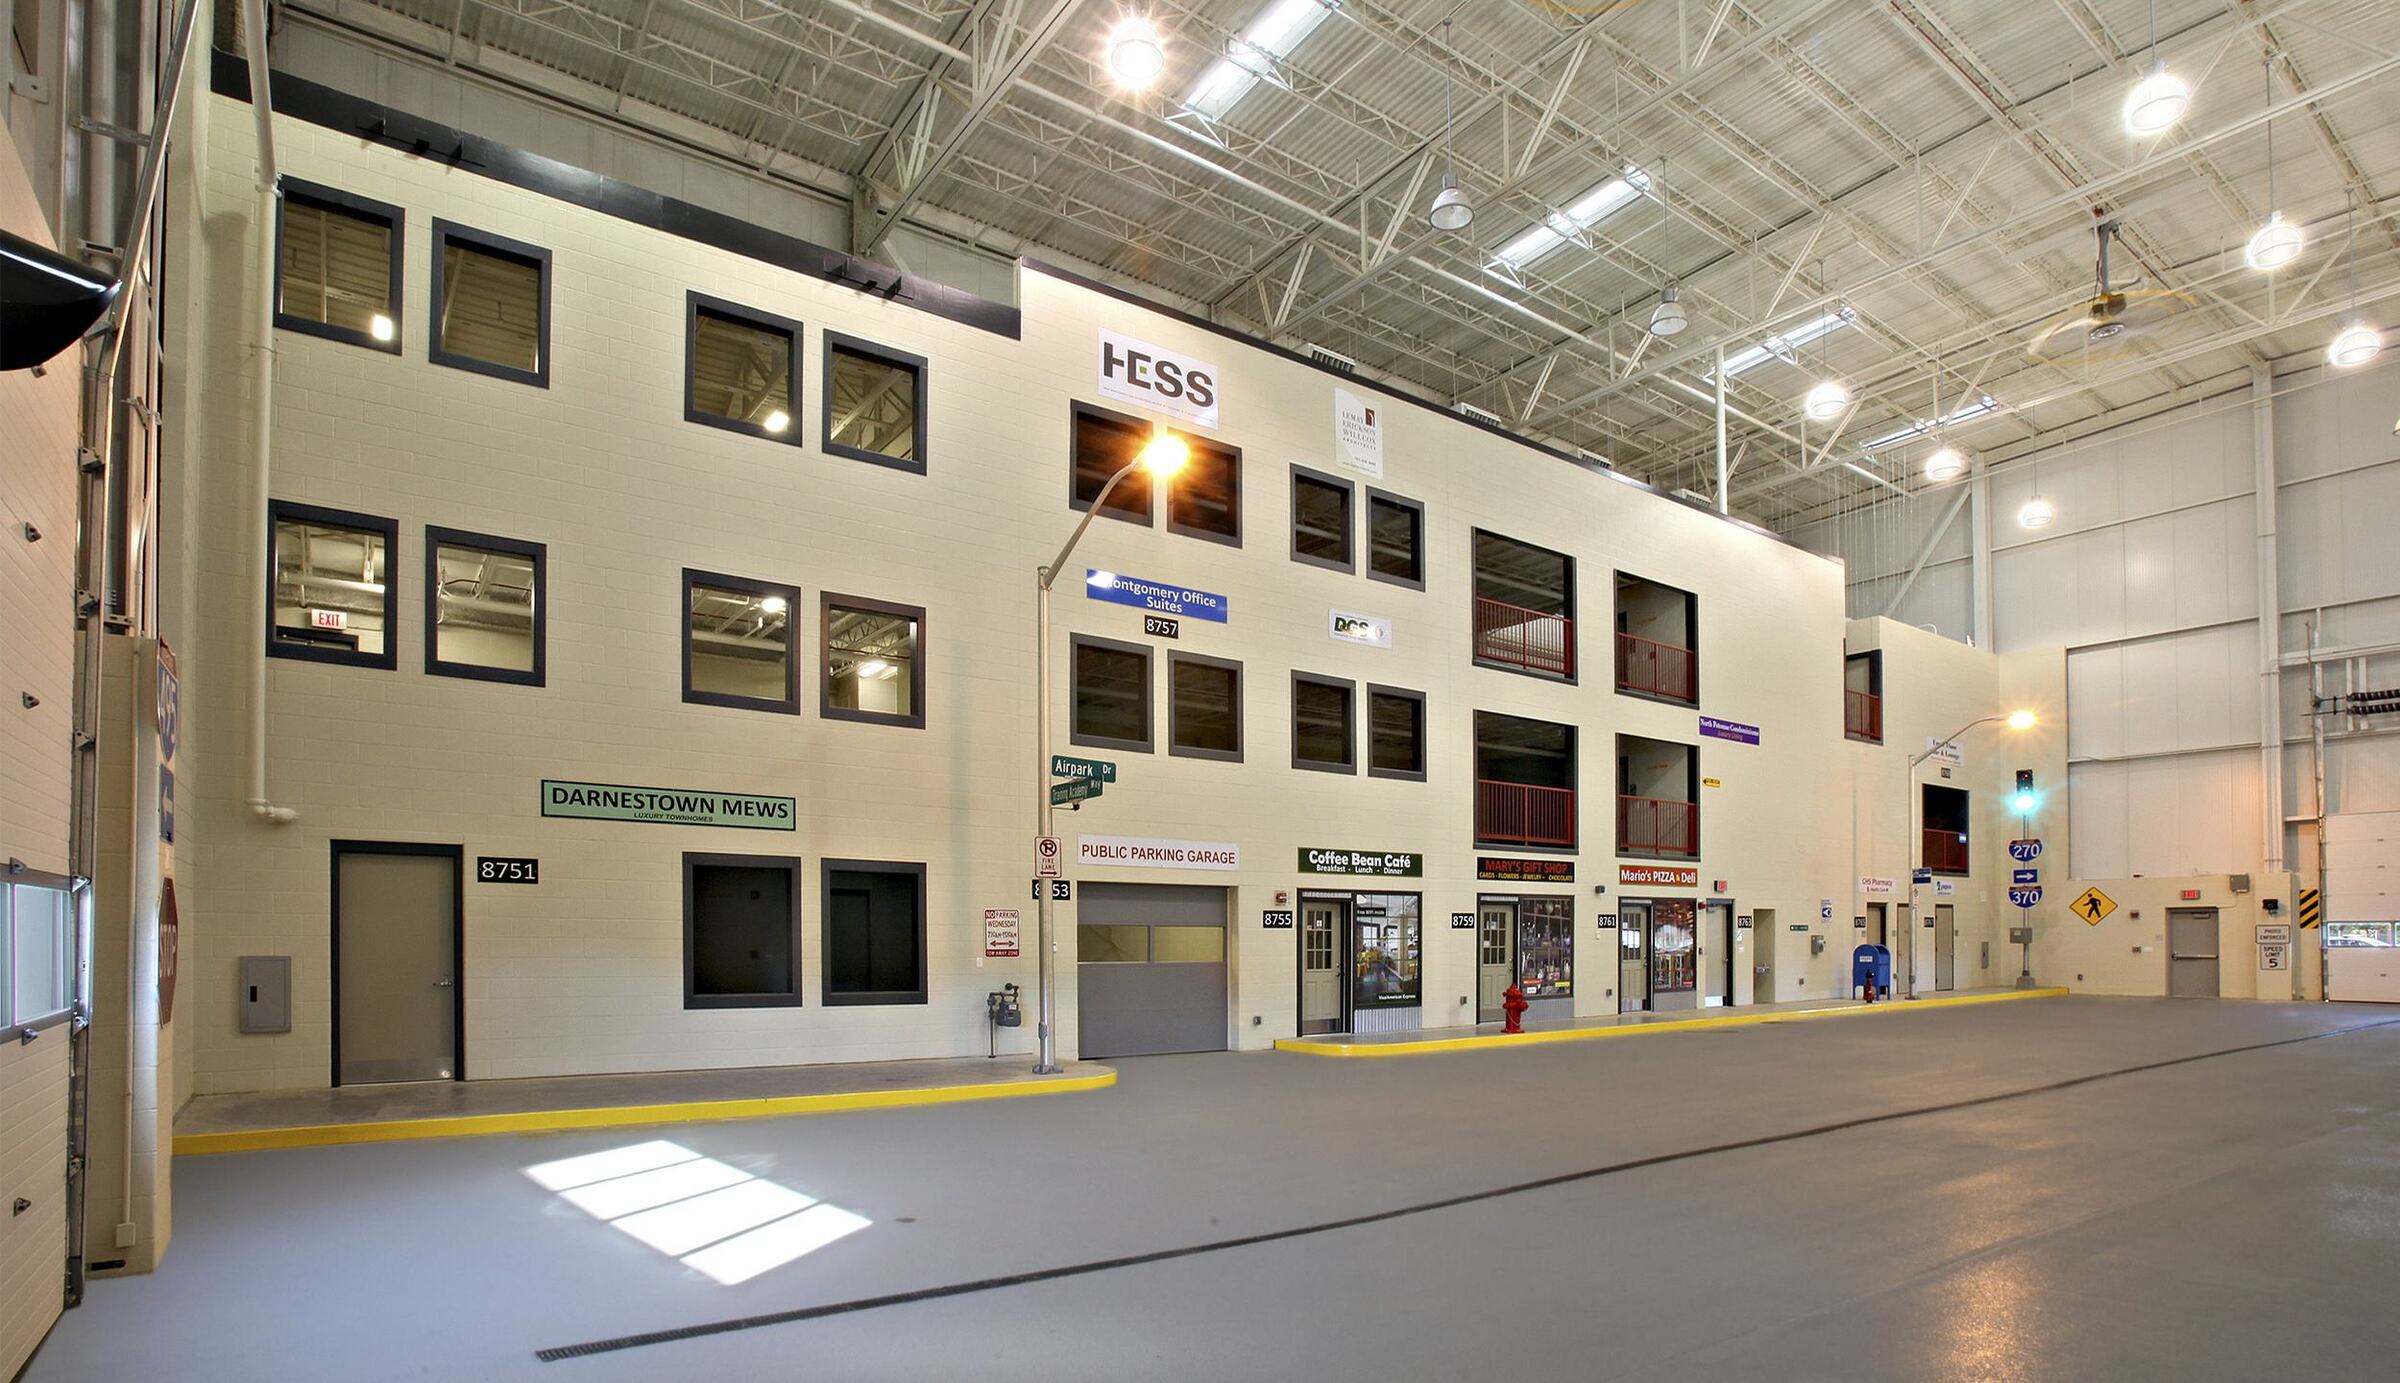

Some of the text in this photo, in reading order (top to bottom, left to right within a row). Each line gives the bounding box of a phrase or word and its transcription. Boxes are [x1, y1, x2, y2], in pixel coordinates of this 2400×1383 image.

[1103, 341, 1214, 408] HESS
[1342, 419, 1376, 437] ERICKSON
[1342, 428, 1377, 445] WILLCOX
[1111, 578, 1217, 608] ontgomery Office
[1146, 596, 1183, 613] Suites
[318, 612, 341, 627] EXIT
[1146, 618, 1178, 636] 8757
[1700, 718, 1712, 728] North
[1055, 759, 1112, 777] Airpark Dr
[1090, 779, 1102, 790] Way
[552, 787, 789, 819] DARNESTOWN MEWS
[633, 811, 714, 823] LUXURY TOWNHOMES
[1081, 844, 1236, 865] PUBLIC PARKING GARAGE
[2013, 843, 2040, 858] 270
[1308, 849, 1411, 868] Coffee Bean Café
[481, 861, 536, 880] 8751
[1316, 864, 1403, 875] Breakfast Lunch Dinner
[1485, 860, 1568, 874] MARY'S GIFT SHOP
[1479, 871, 1495, 879] CARDS
[1498, 872, 1520, 880] FLOWERS
[1548, 873, 1573, 881] CHOCOLATE
[1621, 869, 1652, 882] Mario's
[1652, 871, 1675, 882] PIZZA
[1681, 872, 1696, 883] Deli
[1871, 878, 1893, 887] Pharmacy
[1034, 883, 1069, 897] 853
[2012, 890, 2040, 904] 370
[995, 911, 1018, 919] PARKING
[1264, 913, 1292, 926] 8755
[1452, 915, 1474, 927] 8759
[1598, 916, 1616, 927] 8761
[1737, 917, 1752, 927] 8763
[987, 920, 1017, 928] WEDNESDAY
[160, 923, 177, 979] STOP
[2269, 958, 2278, 968] 5
